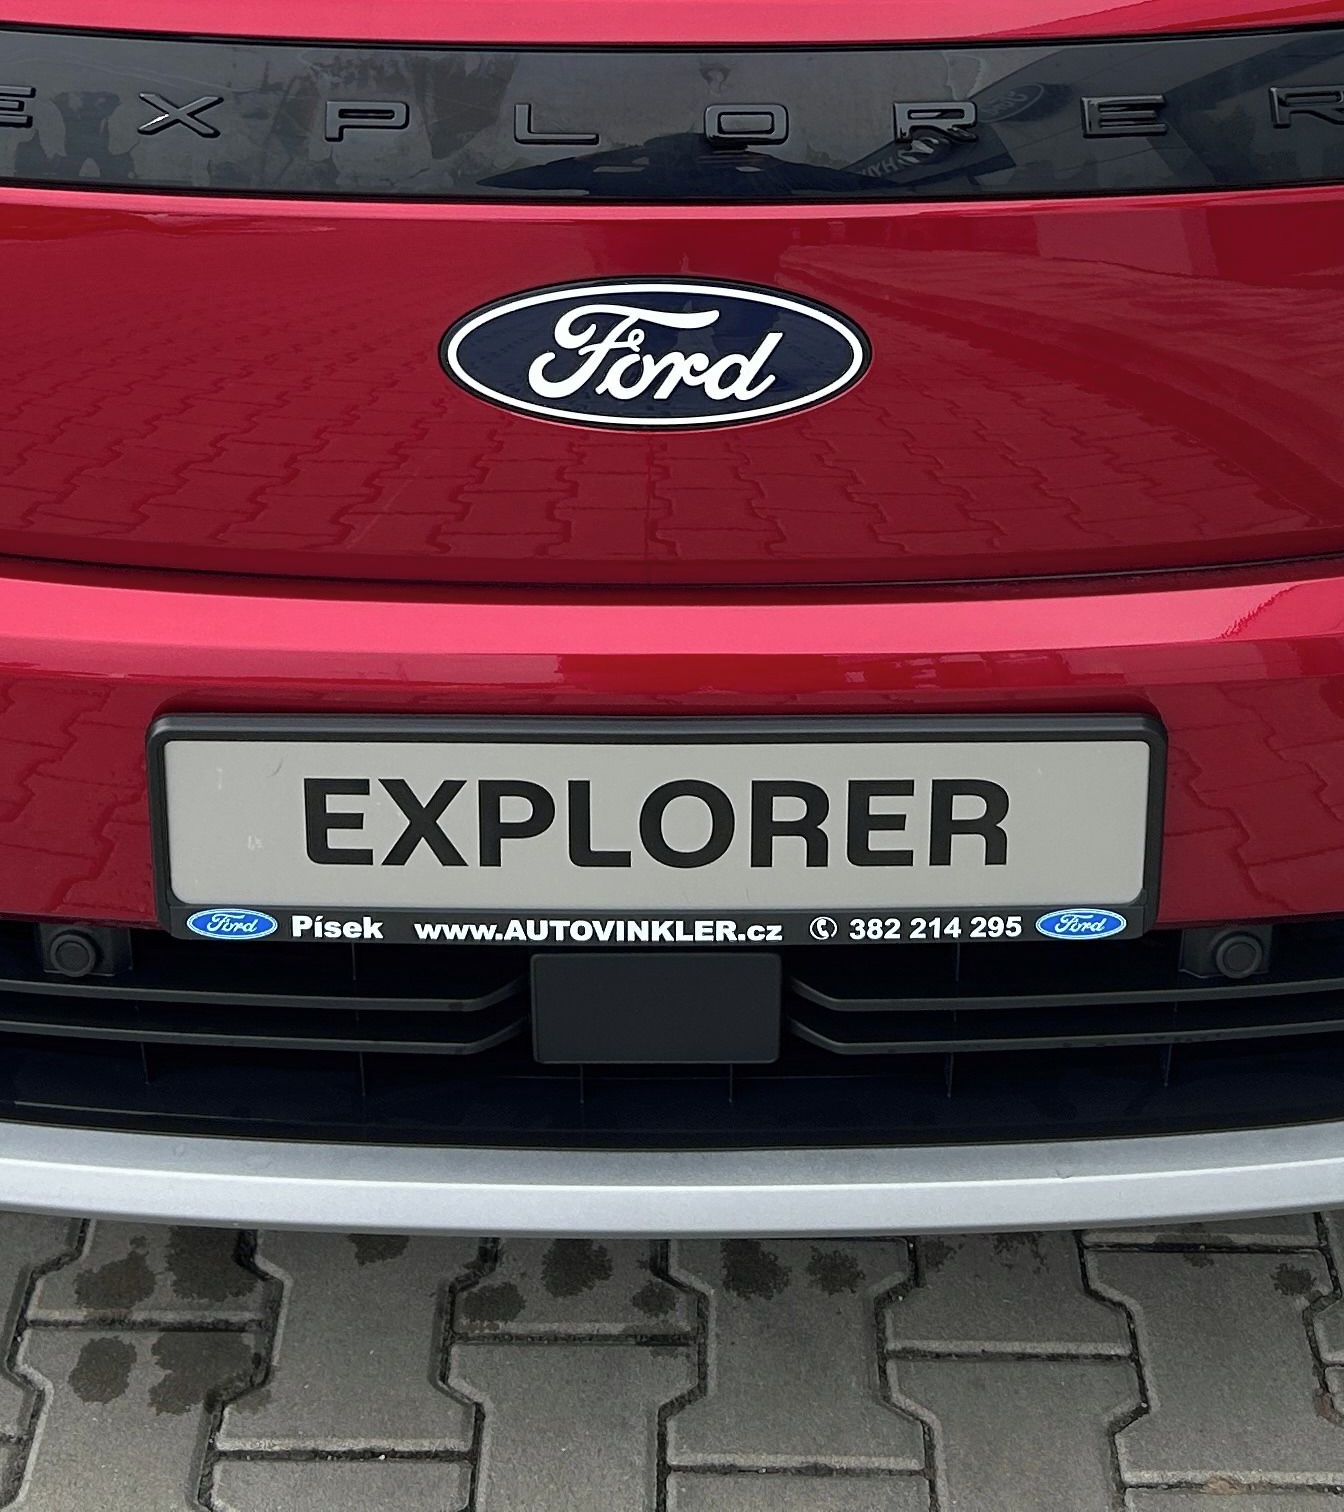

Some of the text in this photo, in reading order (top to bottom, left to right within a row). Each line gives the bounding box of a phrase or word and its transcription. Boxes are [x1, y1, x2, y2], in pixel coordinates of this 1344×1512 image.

[527, 303, 784, 402] Ford
[303, 777, 1010, 869] EXPLORER
[205, 912, 1106, 942] Ford Písek www.AUTOVINKLER.cz 382 214 295 Ford
